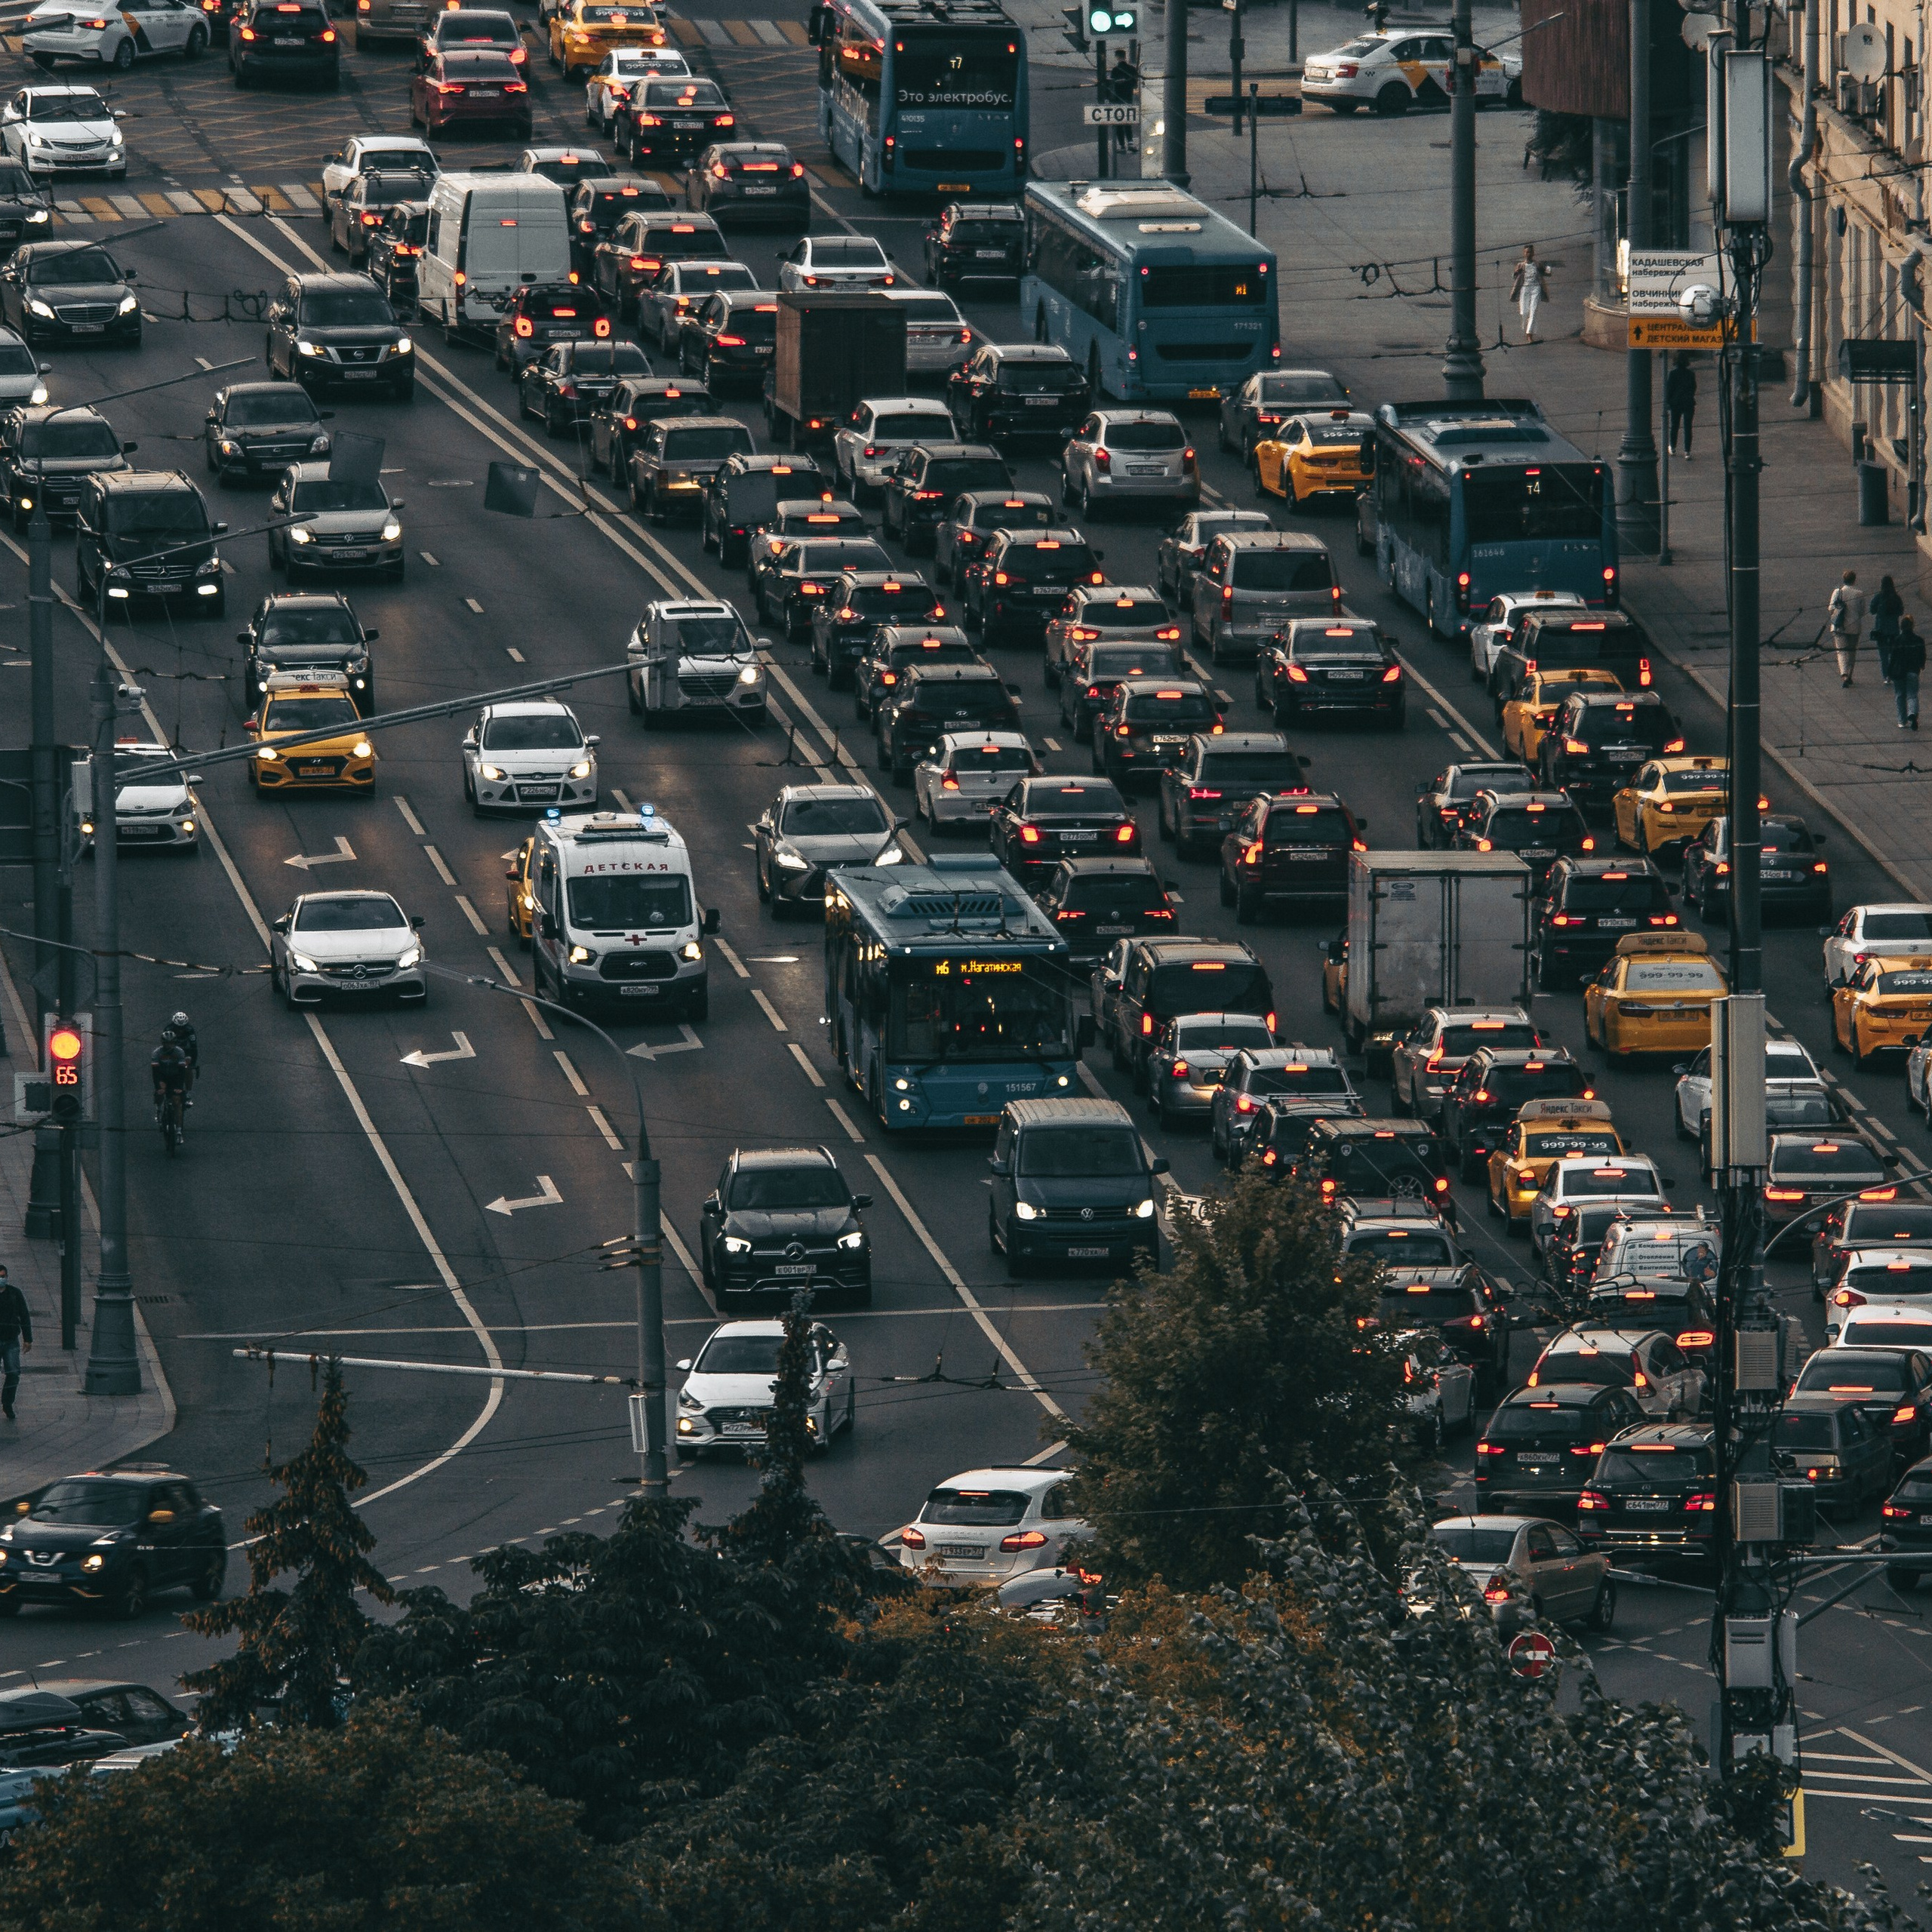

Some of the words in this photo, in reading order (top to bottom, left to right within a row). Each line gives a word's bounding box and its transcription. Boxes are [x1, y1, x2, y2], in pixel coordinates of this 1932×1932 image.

[898, 90, 924, 101] Это
[928, 90, 1012, 105] электробус.
[1091, 108, 1137, 122] СТОП
[1632, 258, 1704, 267] КАДАШЕВСКАЯ
[1632, 269, 1686, 277] набережная
[1632, 300, 1680, 309] набережн
[1647, 334, 1690, 343] ДЕТСКИЙ
[1692, 335, 1724, 343] МАГАЗ
[313, 672, 337, 681] Такси
[584, 863, 669, 874] ДЕТСКАЯ
[1666, 936, 1687, 945] Такси
[1638, 971, 1704, 980] 999-99-99
[56, 1066, 78, 1084] 65
[1006, 1083, 1037, 1093] 151567
[1540, 1103, 1569, 1114] Яндекс
[1570, 1103, 1592, 1113] Такси
[1541, 1141, 1607, 1149] 999-99-99
